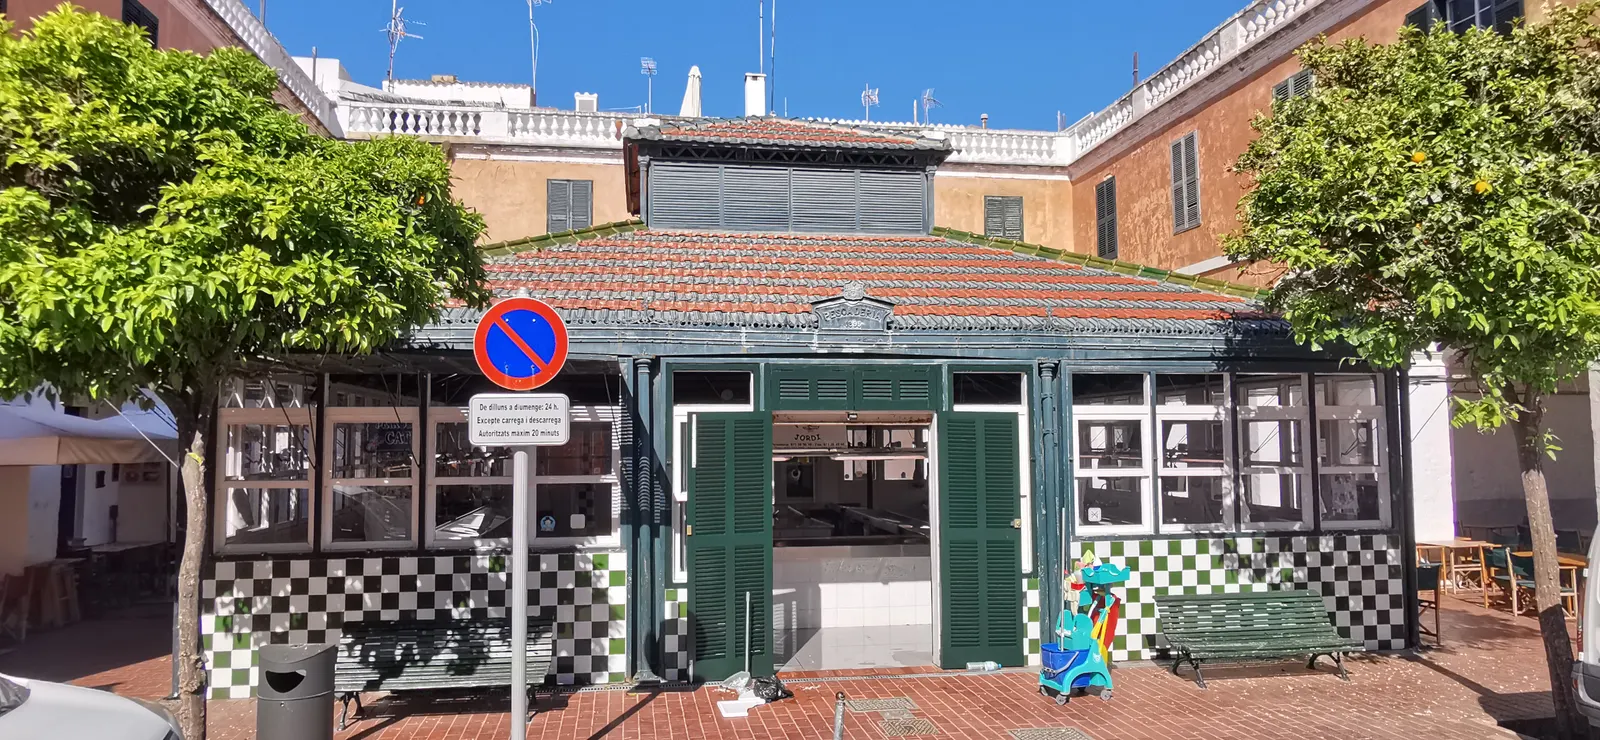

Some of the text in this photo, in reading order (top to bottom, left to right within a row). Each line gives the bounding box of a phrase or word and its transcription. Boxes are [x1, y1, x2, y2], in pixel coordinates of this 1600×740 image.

[488, 403, 508, 411] dilluns
[514, 403, 544, 412] diumenge:
[477, 417, 500, 425] Excepte
[529, 417, 561, 425] descarrega
